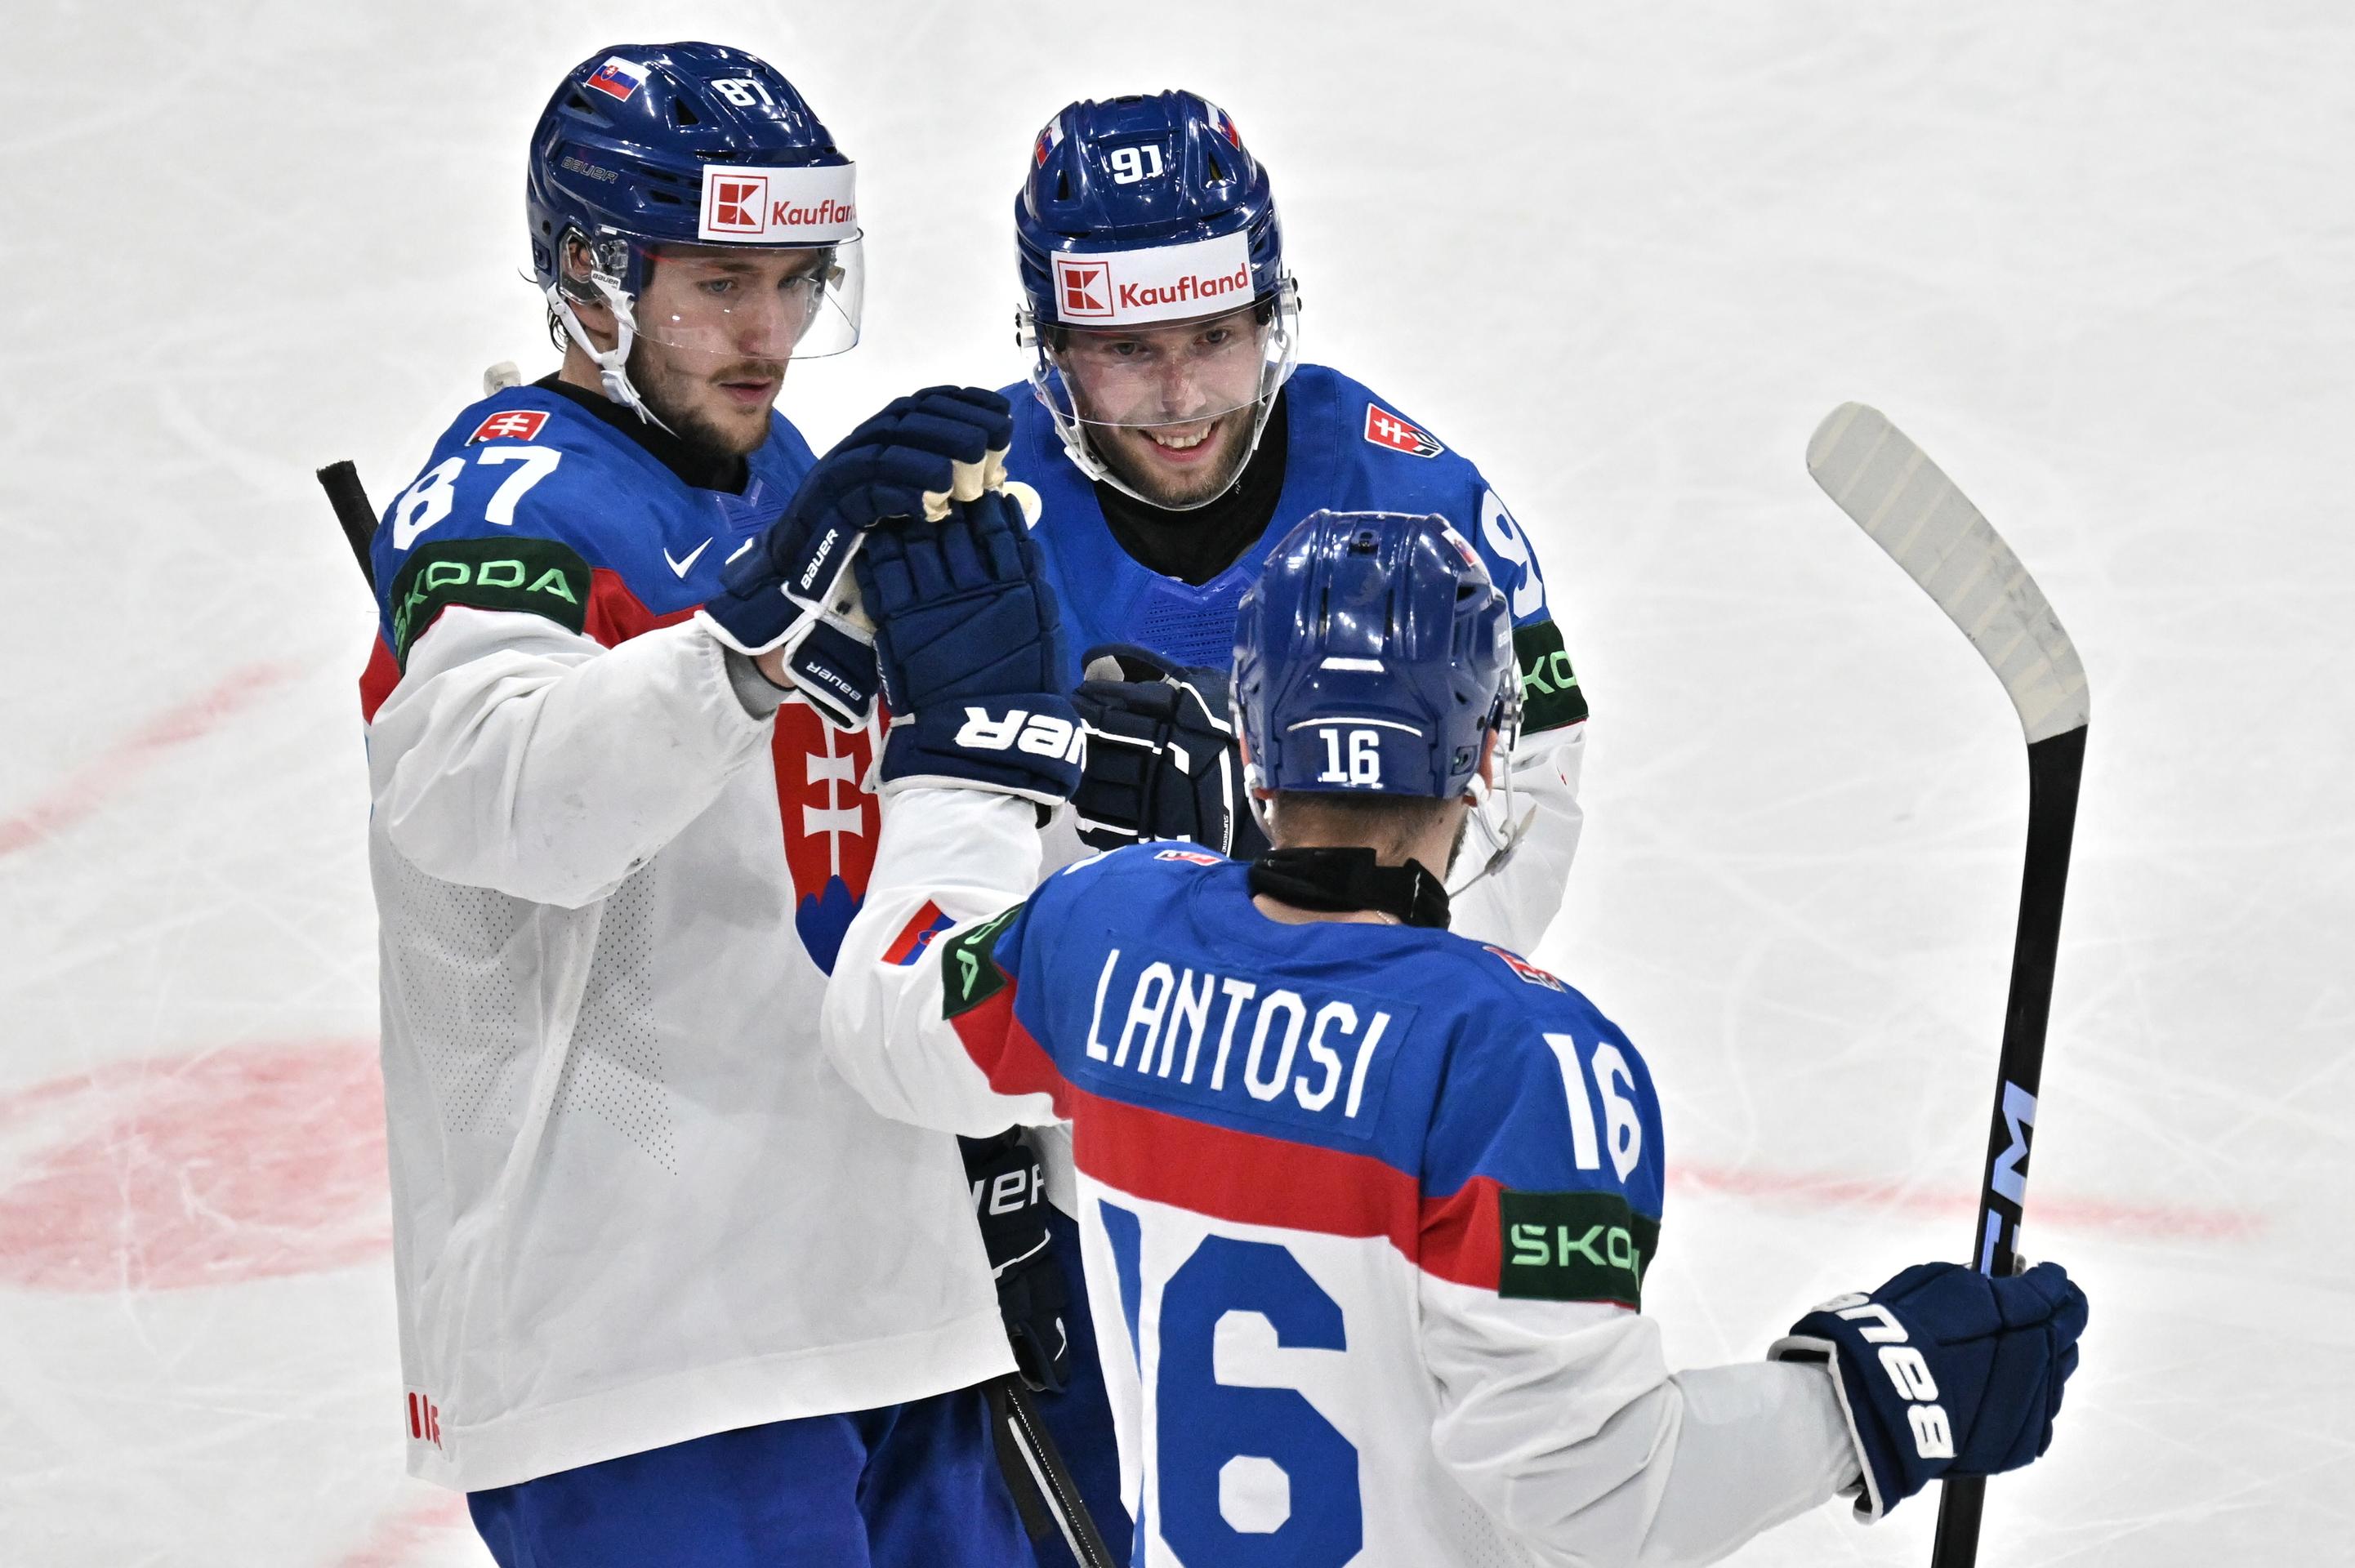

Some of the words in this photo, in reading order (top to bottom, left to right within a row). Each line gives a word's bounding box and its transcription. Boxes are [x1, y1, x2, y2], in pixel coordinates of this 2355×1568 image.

[711, 78, 775, 107] 87
[1110, 144, 1164, 185] 91
[1119, 262, 1248, 309] Kaufland
[392, 445, 562, 550] 87
[1481, 488, 1543, 619] 9
[952, 706, 1087, 773] UER
[1319, 728, 1380, 785] 16
[1086, 948, 1390, 1118] LANTOSI
[1542, 1032, 1642, 1184] 16
[1511, 1223, 1639, 1291] SKO
